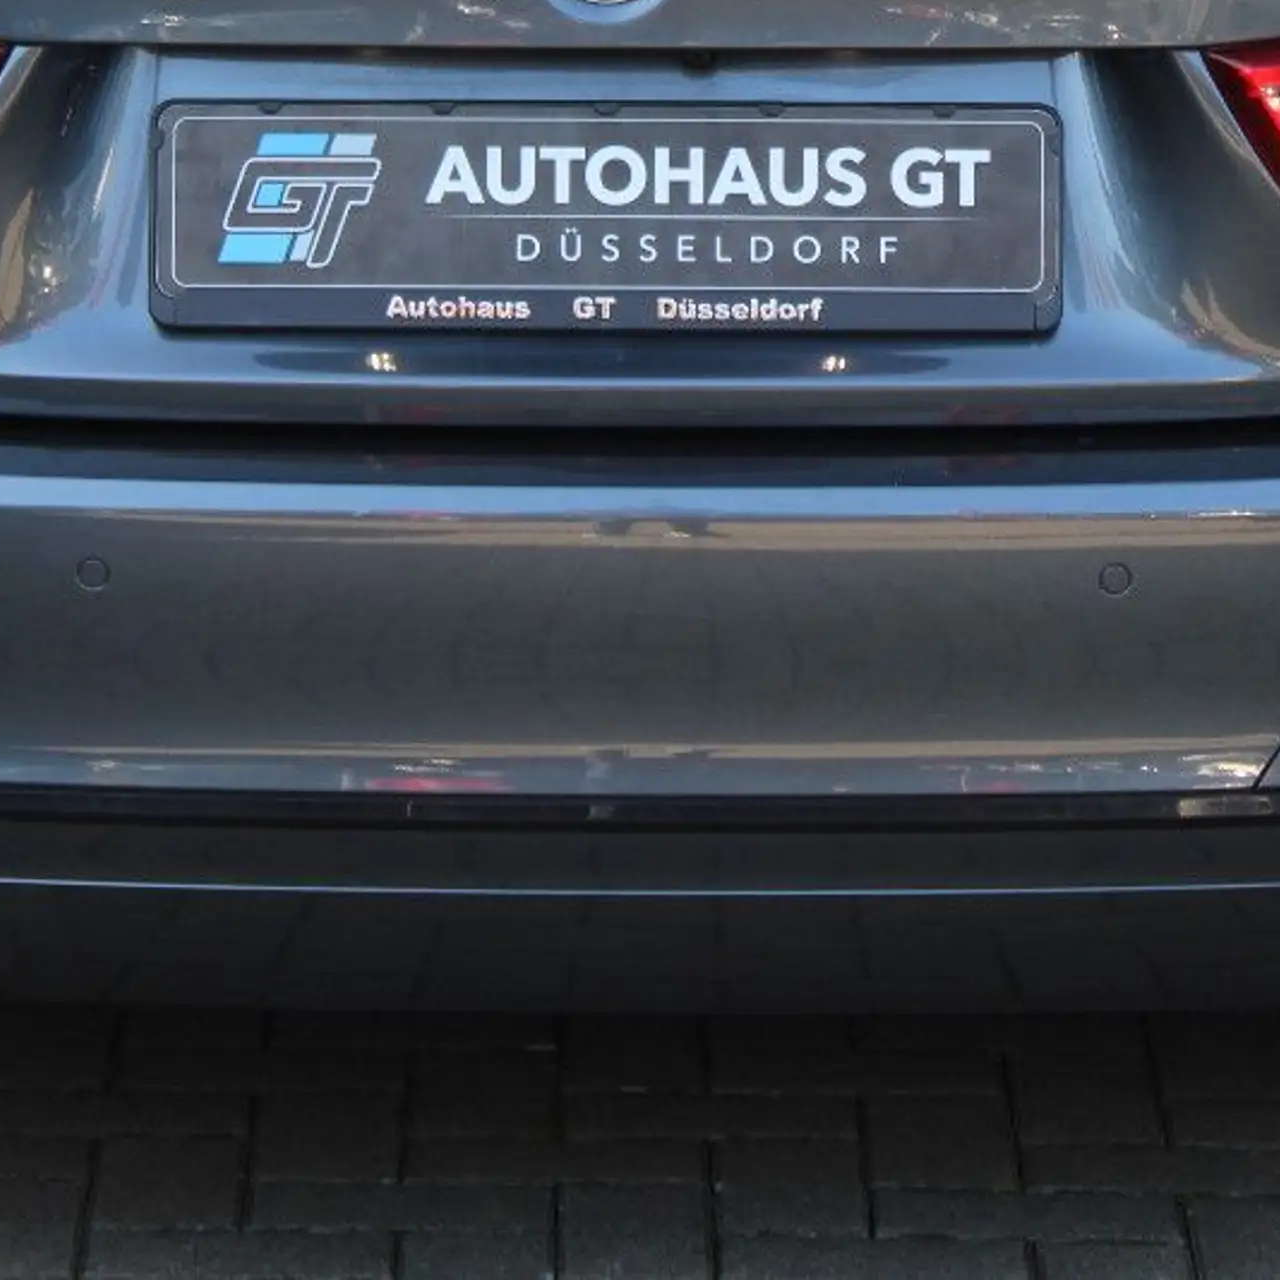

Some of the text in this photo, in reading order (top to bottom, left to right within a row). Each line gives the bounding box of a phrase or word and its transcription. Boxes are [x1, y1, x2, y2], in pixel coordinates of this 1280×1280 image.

[426, 145, 992, 208] AUTOHAUS GT
[516, 227, 900, 264] DÜSSELDORF
[386, 294, 824, 321] Autohaus GT Düsseldorf
